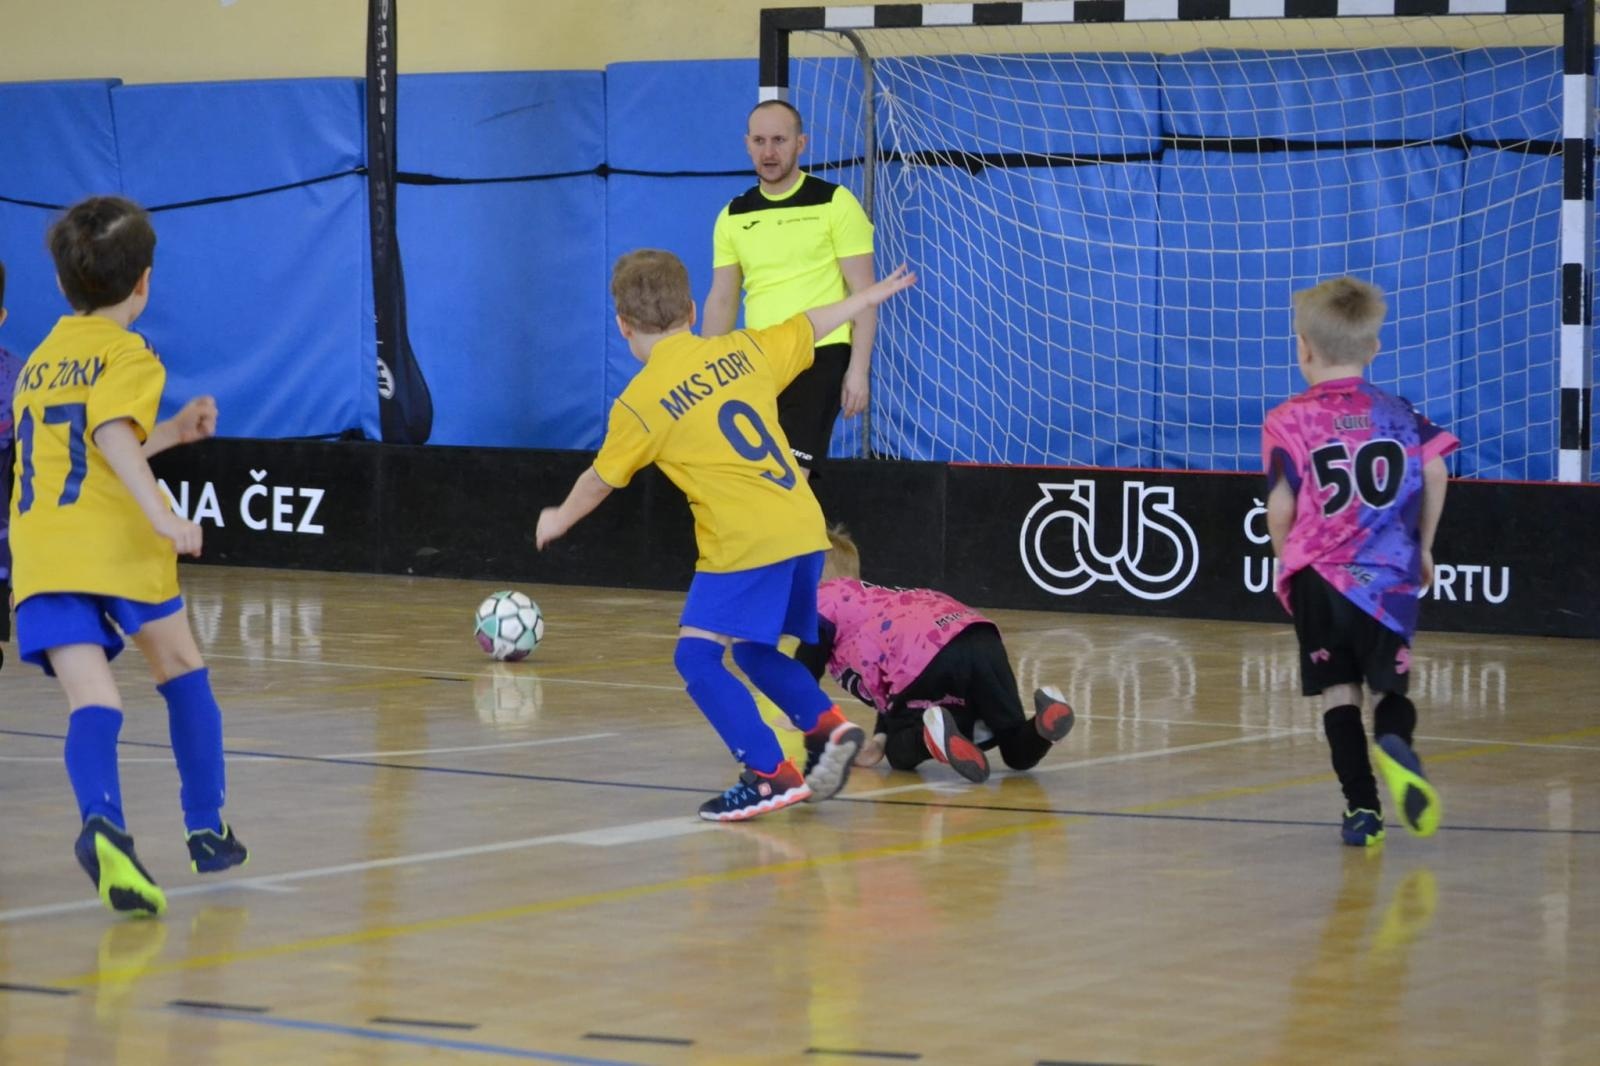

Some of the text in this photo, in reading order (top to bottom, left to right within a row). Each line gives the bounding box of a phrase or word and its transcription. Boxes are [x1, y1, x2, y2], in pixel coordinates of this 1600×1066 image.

[18, 362, 49, 393] KS
[659, 373, 713, 421] MKS
[16, 402, 88, 516] 17
[717, 400, 797, 491] 9
[1311, 438, 1408, 518] 50
[157, 469, 325, 535] NA ČEZ
[1417, 563, 1510, 604] RTU
